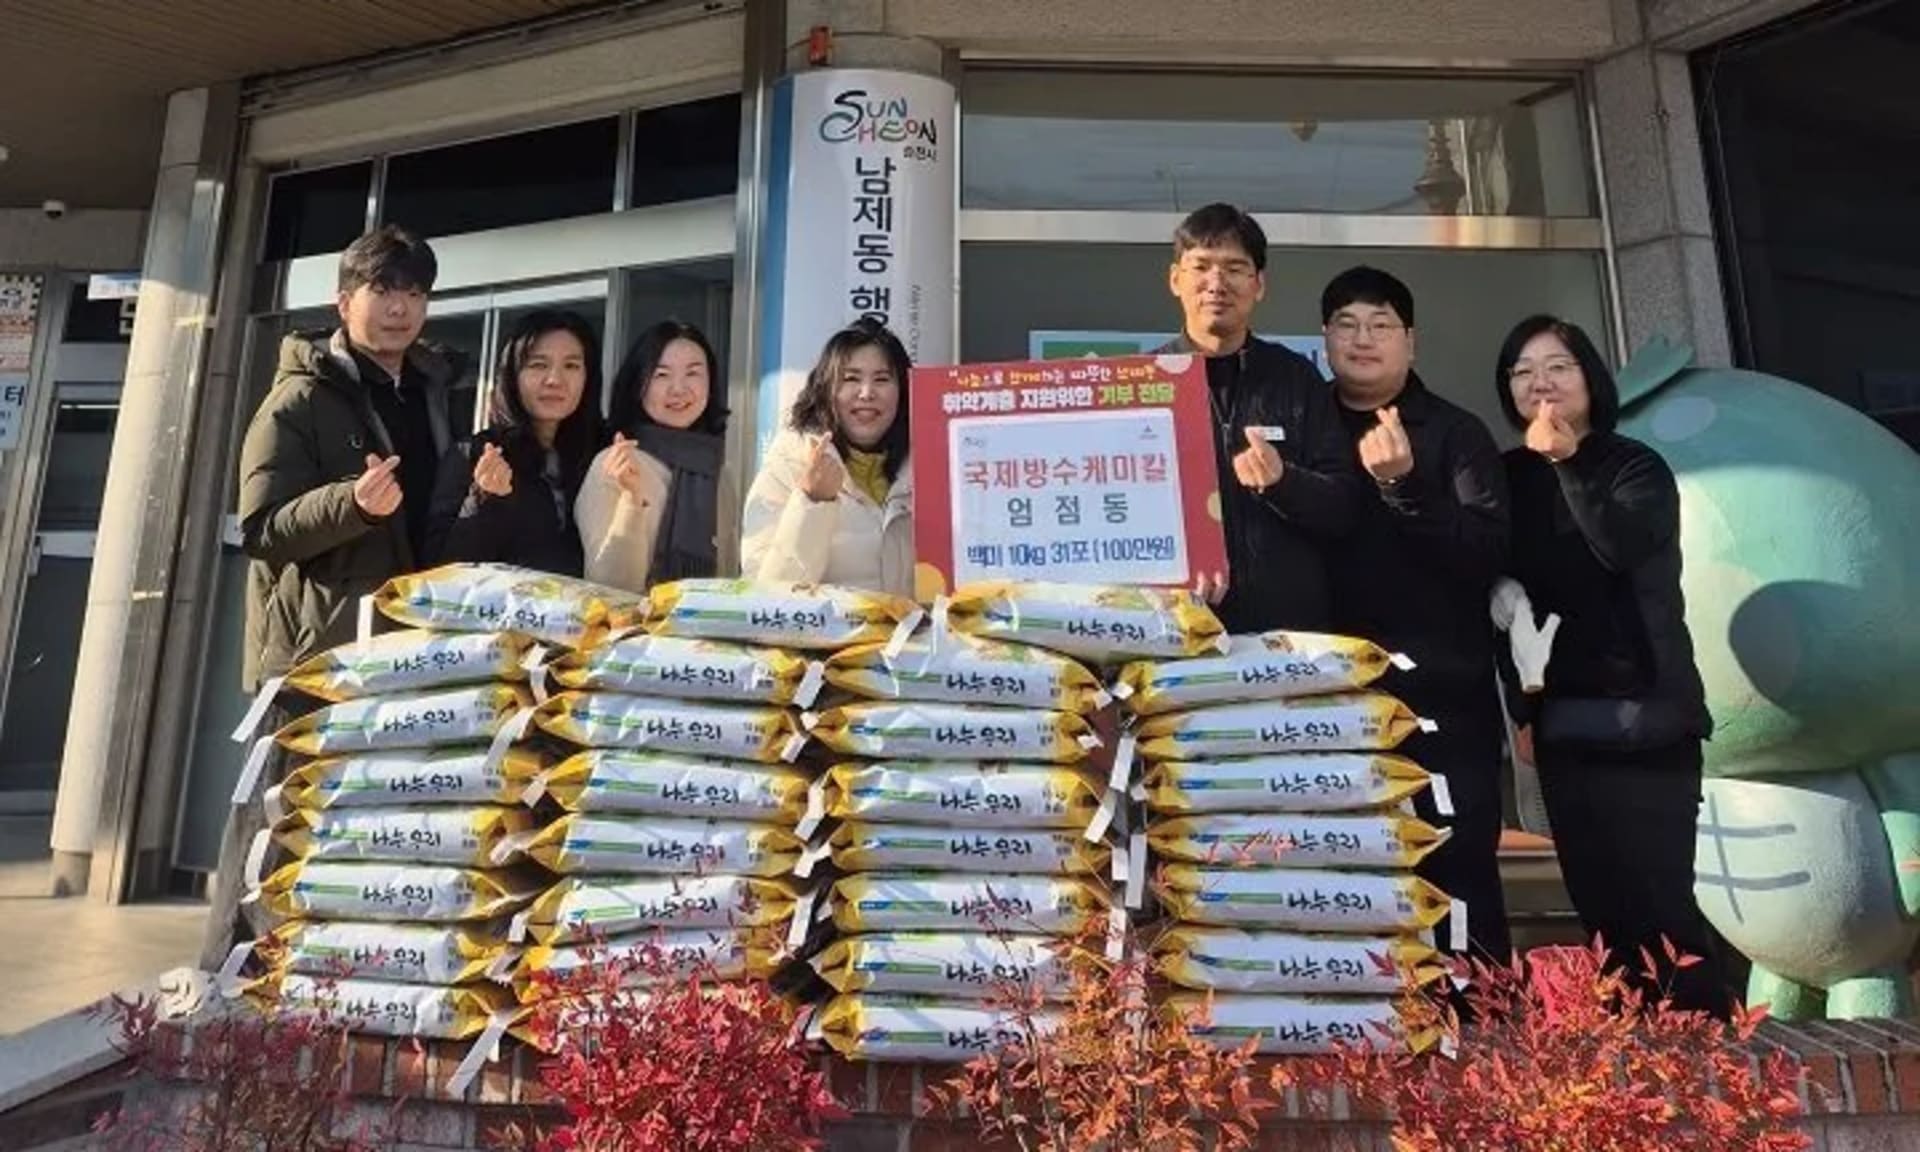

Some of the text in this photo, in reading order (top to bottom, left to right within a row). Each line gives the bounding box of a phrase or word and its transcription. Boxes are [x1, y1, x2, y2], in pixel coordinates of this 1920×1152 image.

[834, 90, 908, 134] SUN
[852, 157, 897, 274] 남제동
[942, 382, 1175, 413] 취약계층 지원위한 기부 전달
[963, 452, 1168, 490] 국제방수케미칼
[967, 542, 1003, 567] 백미
